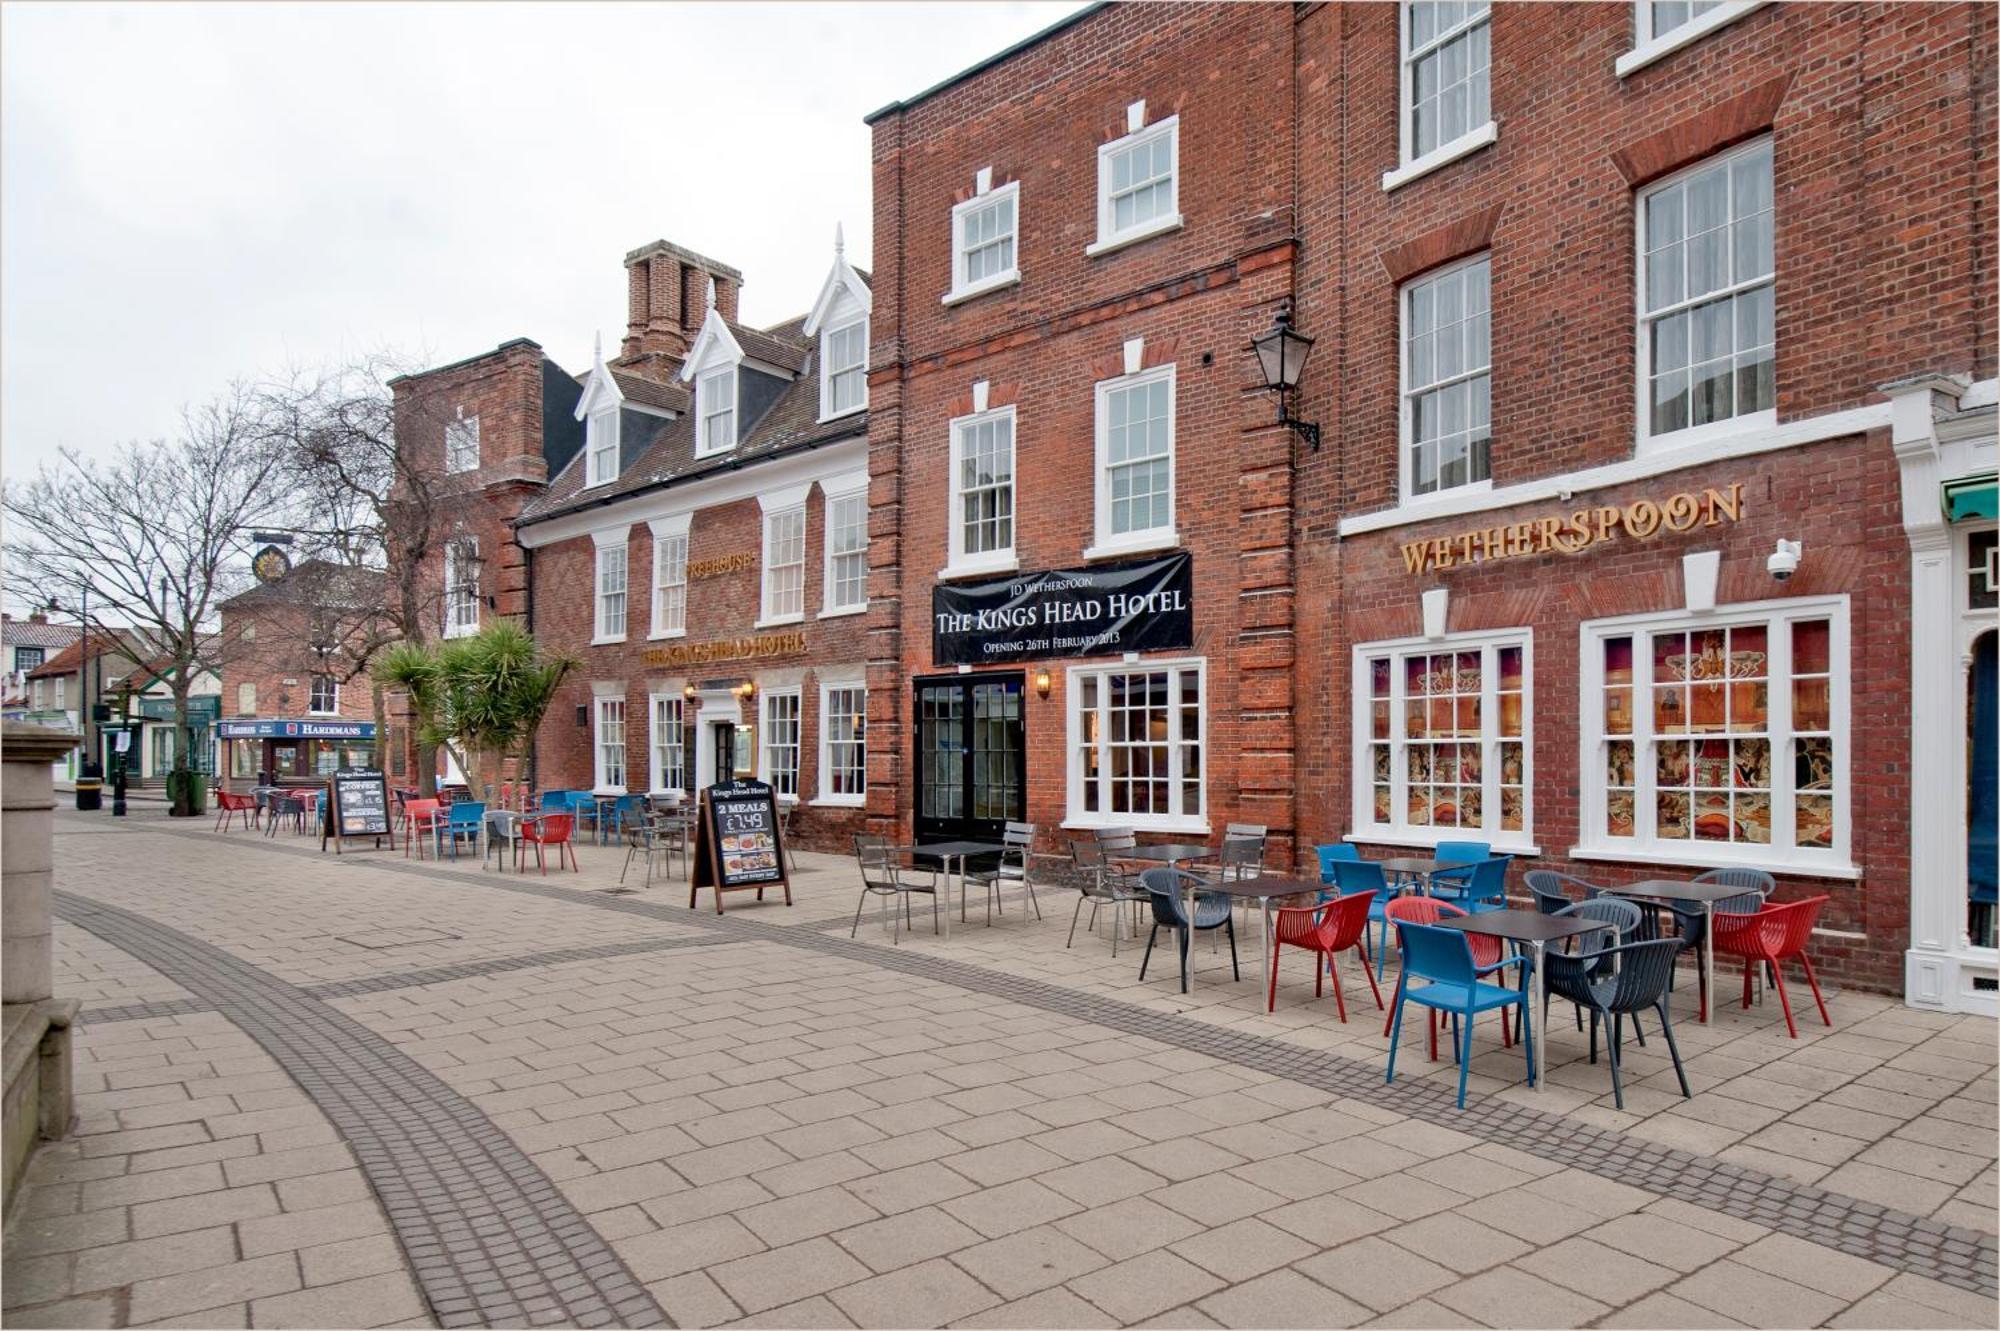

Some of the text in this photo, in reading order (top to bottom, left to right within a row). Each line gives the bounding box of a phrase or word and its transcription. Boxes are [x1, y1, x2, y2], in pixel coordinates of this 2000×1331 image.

[1400, 483, 1745, 576] WETHERSPOON
[1010, 577, 1093, 598] JD WETHERSPOON
[936, 590, 1186, 634] THE KINGS HEAD HOTEL
[983, 631, 1120, 654] OPENING 26TH FEBRUARY 2013
[712, 787, 768, 798] Kings Head Hotel
[718, 802, 768, 814] 2 MEALS
